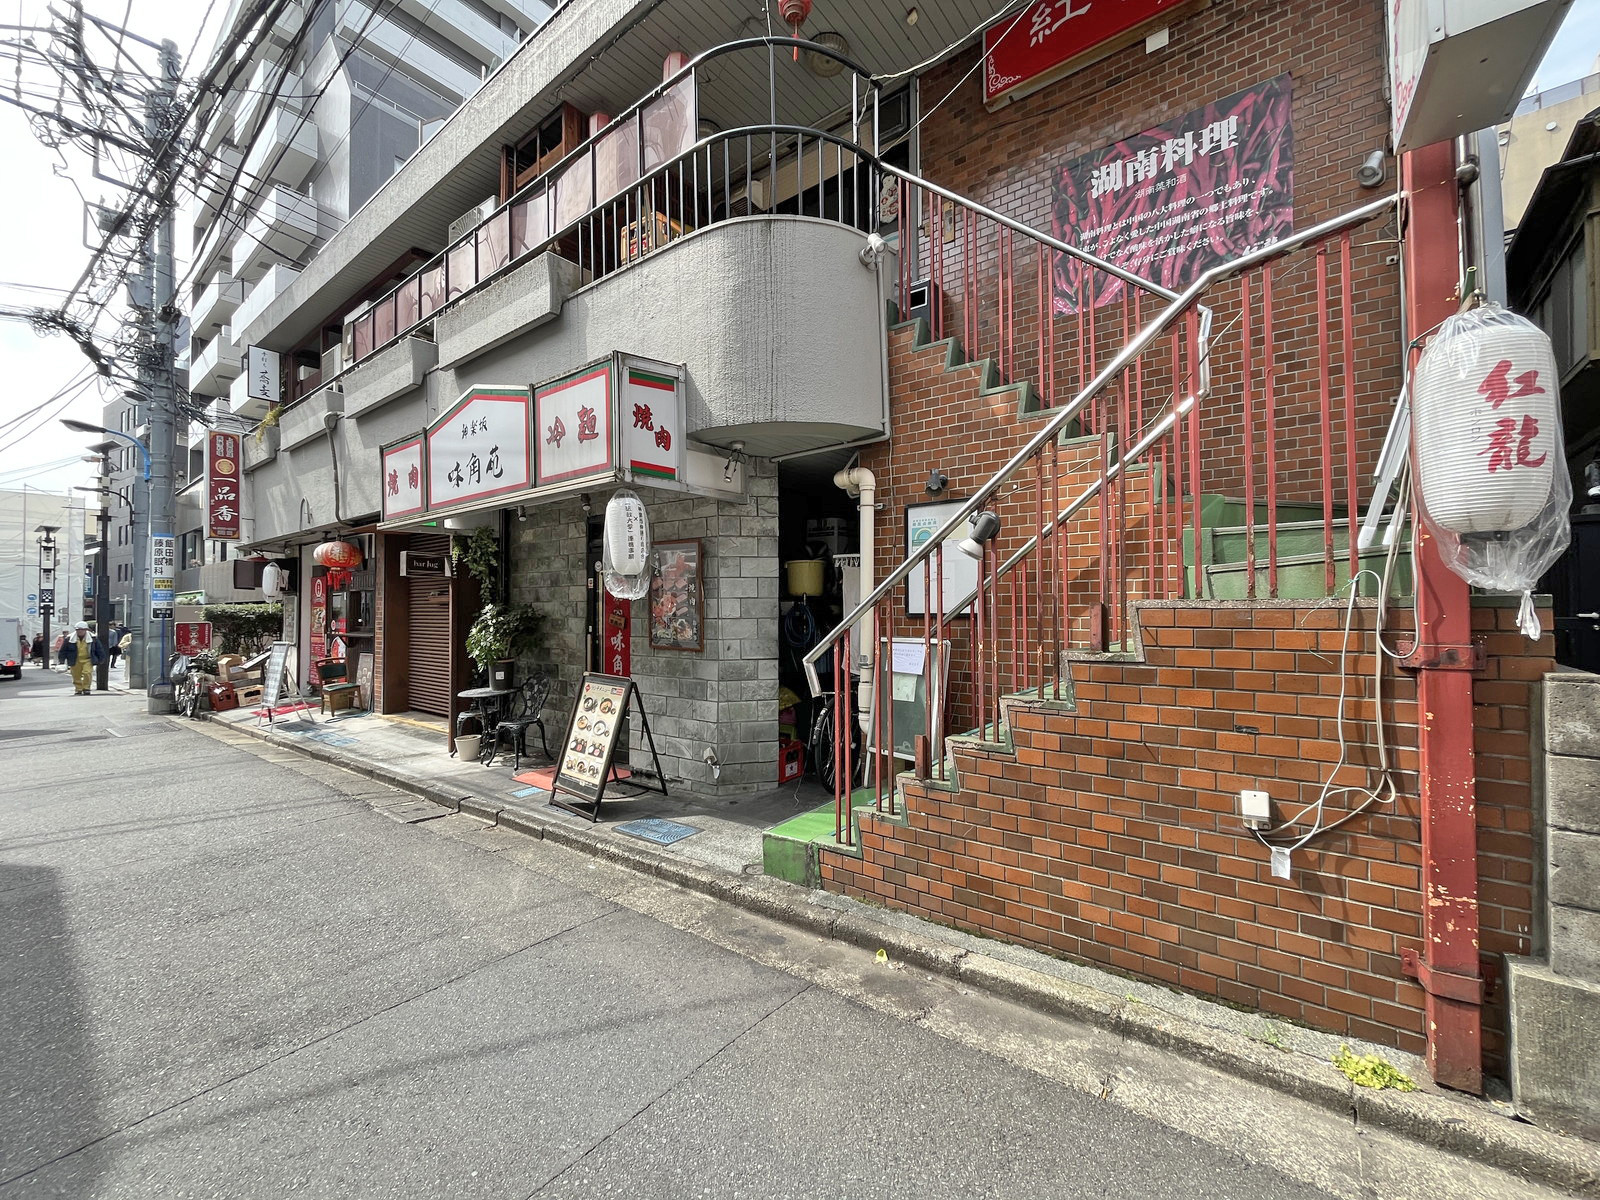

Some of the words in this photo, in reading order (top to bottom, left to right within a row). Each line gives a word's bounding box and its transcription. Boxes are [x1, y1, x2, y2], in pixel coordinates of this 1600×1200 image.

[1090, 115, 1239, 199] 湖南料理
[461, 415, 488, 440] 神楽坂
[632, 403, 672, 452] 焼肉
[1476, 359, 1548, 474] 紅龍
[387, 463, 419, 498] 焼肉
[447, 444, 504, 489] 味角苑
[212, 477, 239, 522] 一品香
[165, 539, 174, 567] 飯田橋
